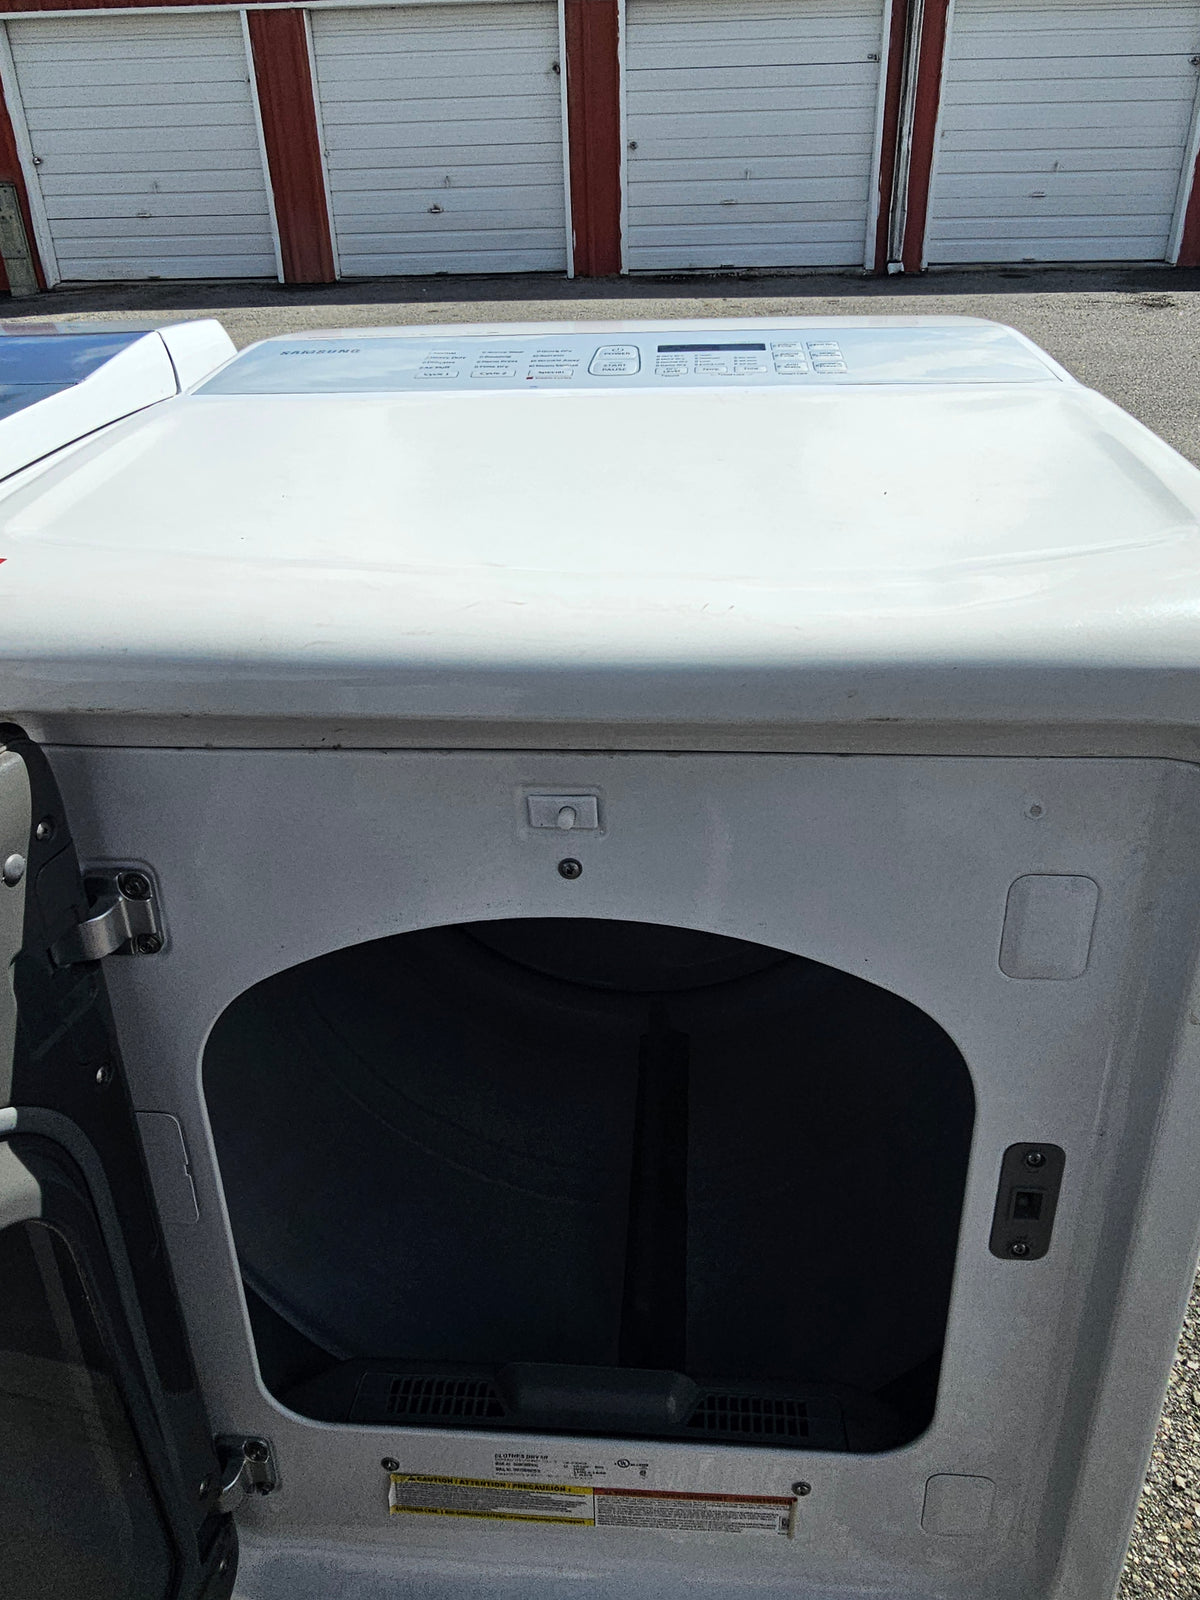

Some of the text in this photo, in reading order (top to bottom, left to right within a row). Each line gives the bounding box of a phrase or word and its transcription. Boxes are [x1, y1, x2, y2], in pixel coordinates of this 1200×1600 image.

[279, 348, 361, 356] SAMSUNG
[416, 1476, 453, 1484] CAUTION
[460, 1479, 505, 1488] ATTENTION
